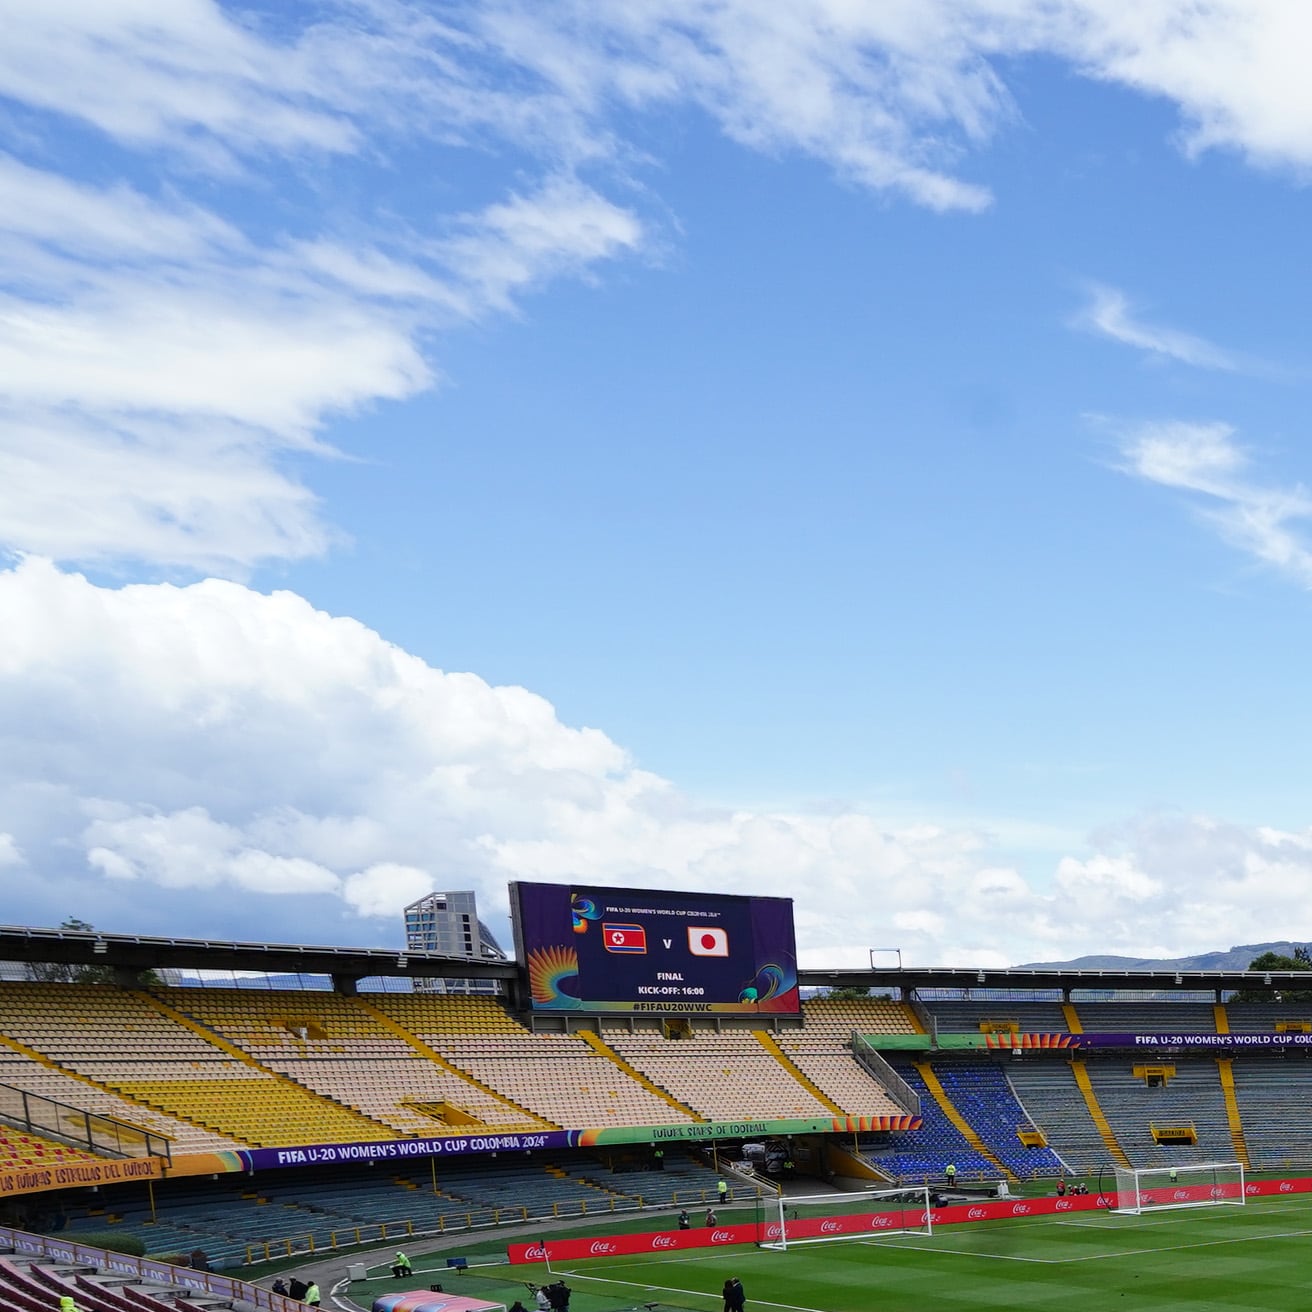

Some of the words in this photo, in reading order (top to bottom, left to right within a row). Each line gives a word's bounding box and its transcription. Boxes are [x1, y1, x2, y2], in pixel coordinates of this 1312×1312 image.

[657, 972, 684, 981] FINAL
[638, 986, 681, 995] KICK-OFF:
[682, 987, 705, 995] 16:00
[633, 1003, 712, 1012] #FIFAU20WWC
[1135, 1036, 1158, 1045] FIFA
[1160, 1036, 1183, 1045] U-20
[1184, 1036, 1232, 1045] WOMEN'S
[1234, 1036, 1269, 1044] WORLD
[1271, 1035, 1292, 1044] CUP
[716, 1126, 726, 1134] OF
[278, 1150, 307, 1164] FIFA
[309, 1148, 336, 1161] U-20
[338, 1144, 396, 1159] WOMEN'S
[398, 1141, 442, 1156] WORLD
[444, 1139, 468, 1152] CUP
